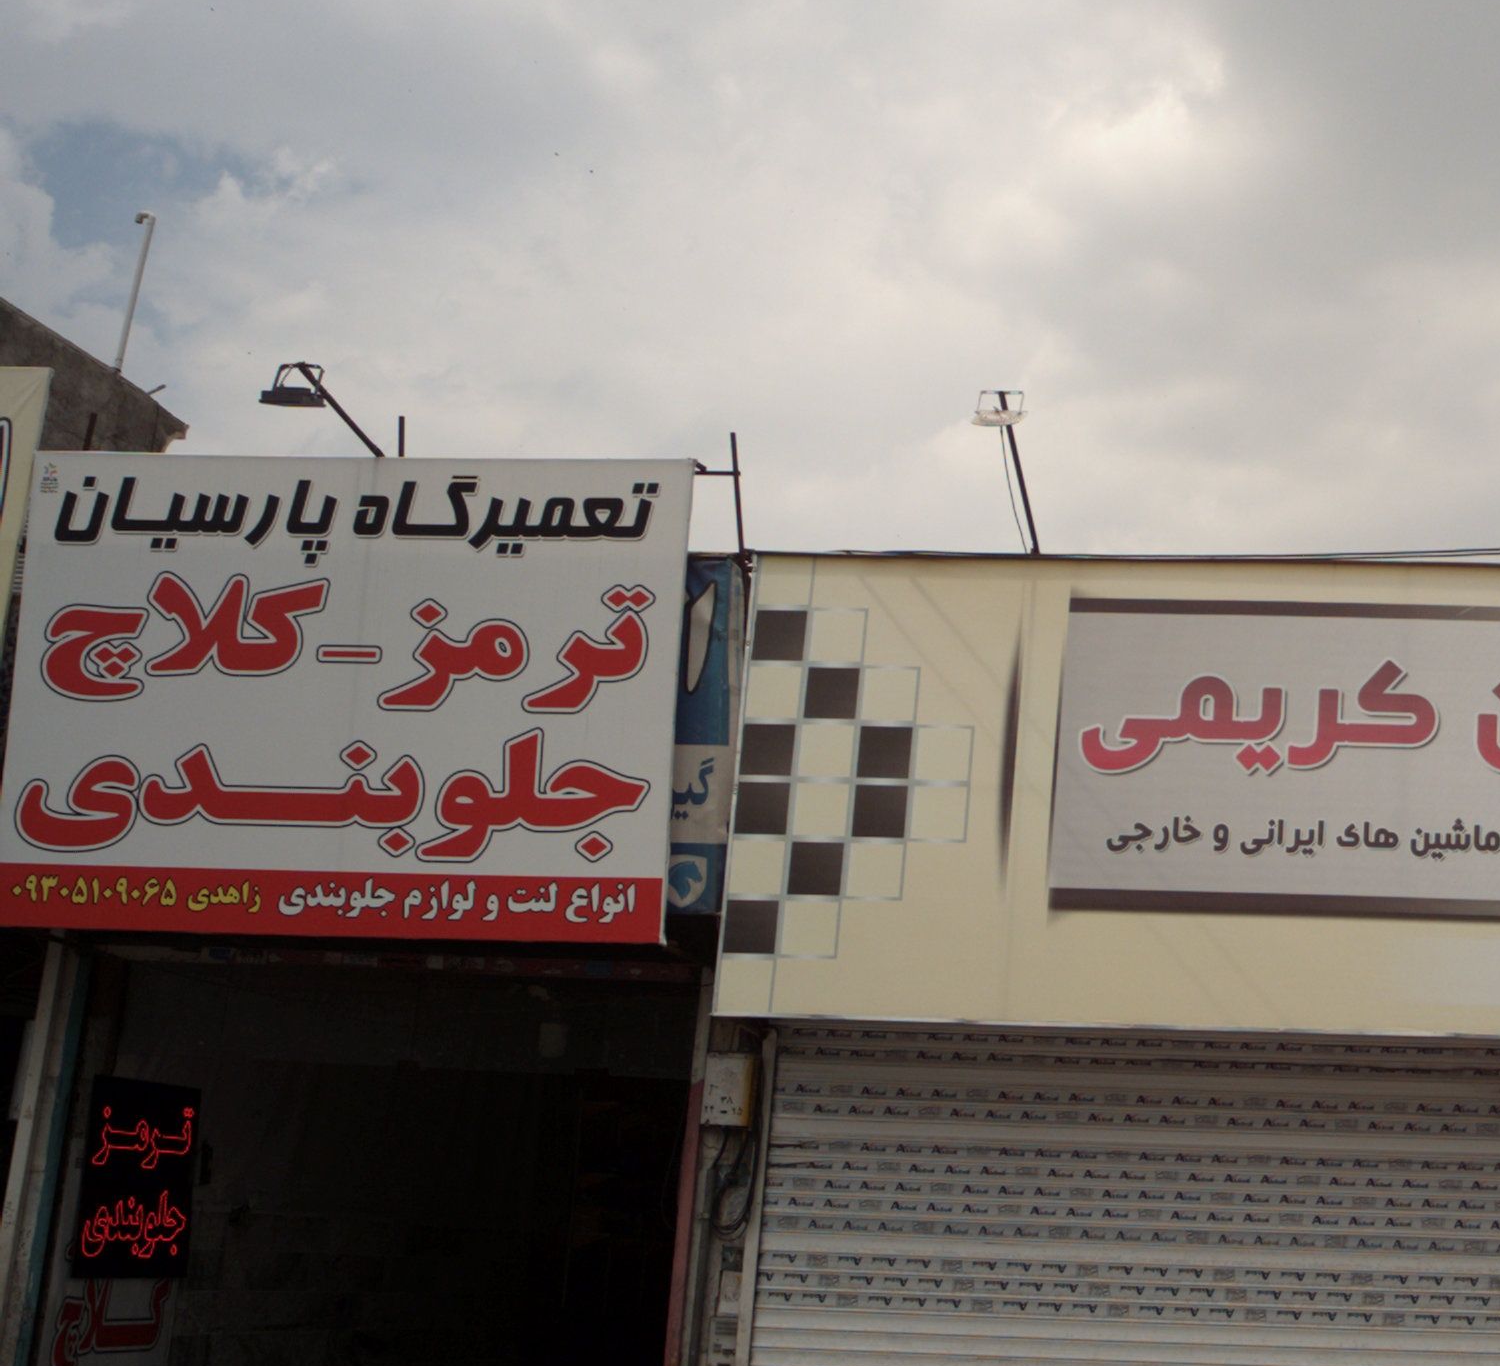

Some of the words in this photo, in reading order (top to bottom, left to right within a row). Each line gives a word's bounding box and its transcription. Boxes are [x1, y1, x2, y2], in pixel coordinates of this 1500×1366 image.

[53, 473, 340, 567] پارسیان
[351, 473, 662, 557] تعمیرگاه
[41, 571, 330, 702] کلاچ
[376, 585, 656, 715] ترمز
[1078, 657, 1444, 778] کریمی
[13, 727, 652, 863] جلوبندی
[1105, 815, 1202, 854] خارجی
[1212, 823, 1231, 852] و
[1239, 820, 1327, 857] ایرانی
[1335, 825, 1401, 851] های
[11, 873, 179, 908] ۰۹۳۰۵۱۰۹۰۶۵
[186, 879, 262, 914] زاهدی
[277, 875, 396, 918] جلوبندی
[402, 878, 479, 919] لوازم
[484, 890, 502, 921] و
[506, 877, 559, 918] لنت
[563, 882, 637, 925] انواع
[91, 1104, 195, 1170] ترمز
[80, 1188, 188, 1259] جلوبندی
